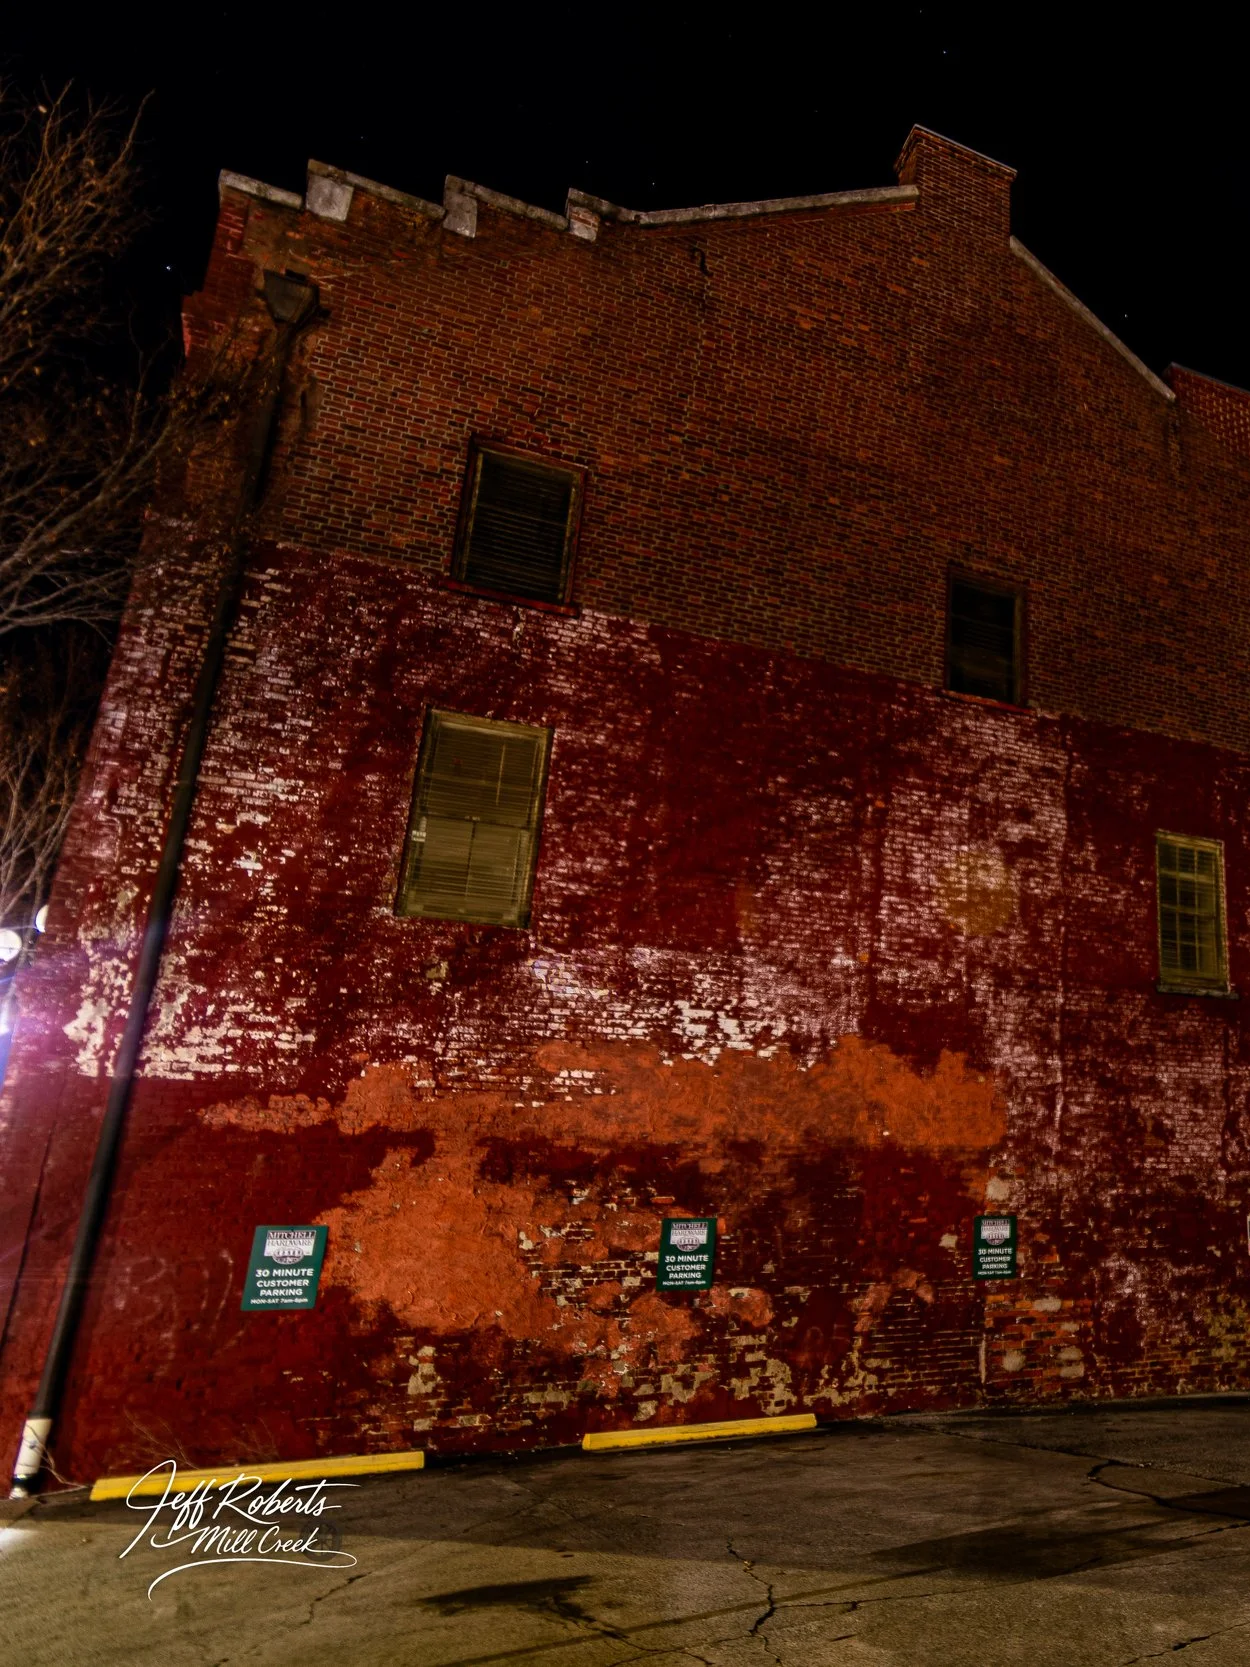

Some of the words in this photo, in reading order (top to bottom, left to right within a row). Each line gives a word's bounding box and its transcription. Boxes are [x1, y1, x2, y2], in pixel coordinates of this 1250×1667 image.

[268, 1231, 315, 1239] MITCHELL
[665, 1255, 676, 1263] 30
[677, 1254, 709, 1262] MINUTE
[255, 1269, 270, 1277] 30
[272, 1268, 314, 1277] MINUTE
[256, 1279, 310, 1288] CUSTOMER
[260, 1288, 303, 1297] PARKING
